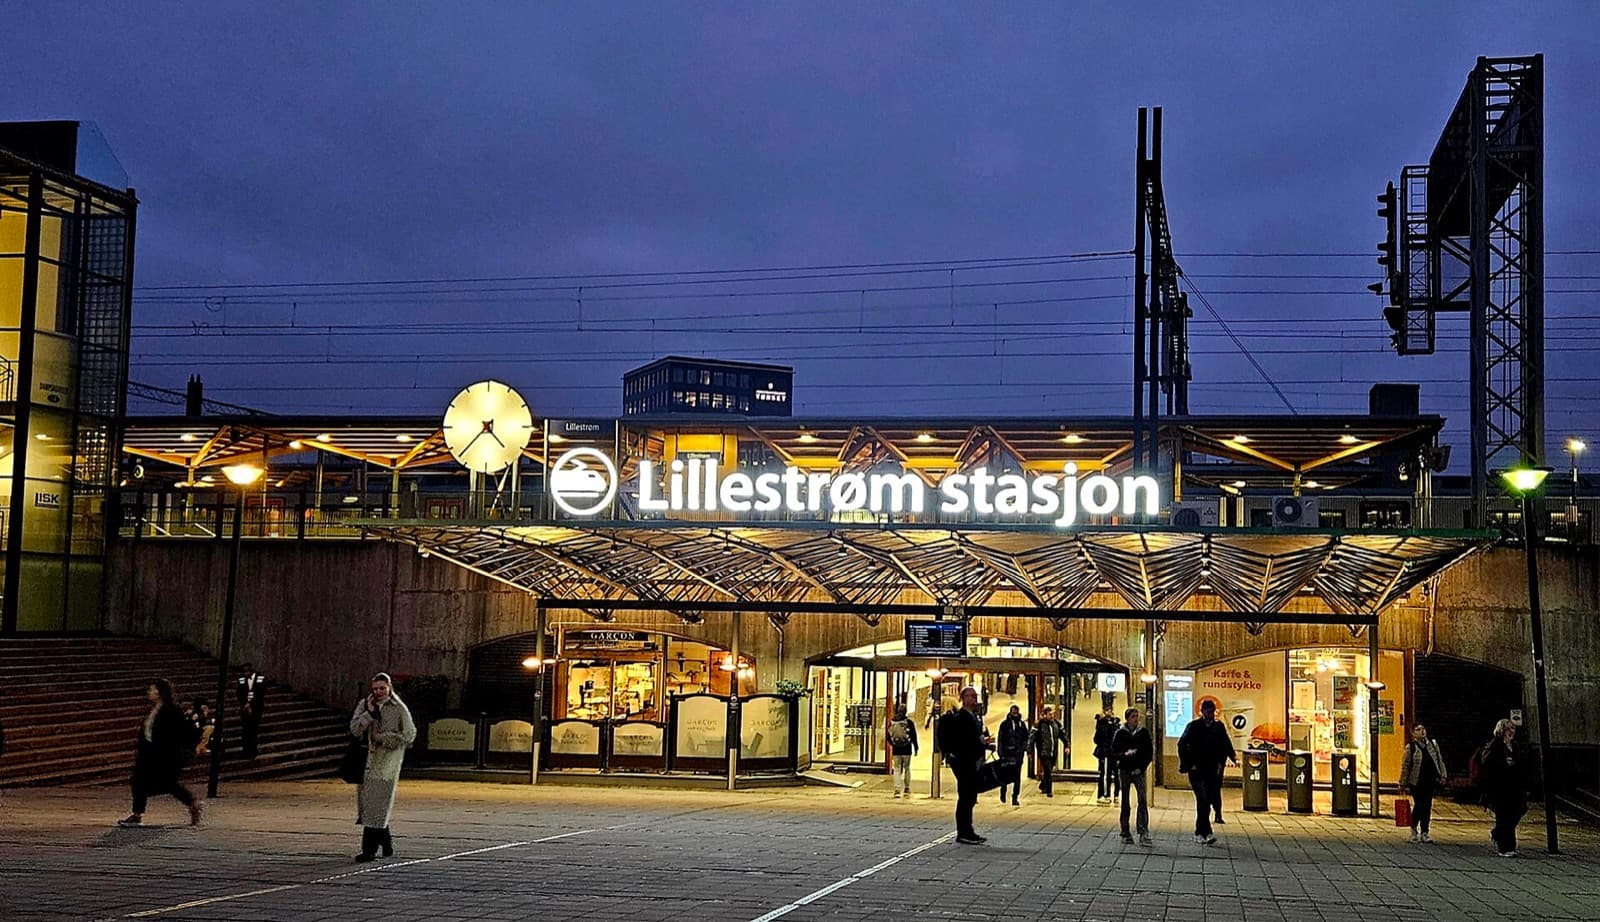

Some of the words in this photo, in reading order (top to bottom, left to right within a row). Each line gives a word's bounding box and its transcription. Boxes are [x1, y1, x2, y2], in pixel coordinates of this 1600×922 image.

[638, 459, 925, 513] Lillestrøm
[940, 462, 1161, 528] stasjon
[1213, 669, 1242, 678] Kaffe
[1243, 670, 1251, 678] &
[1203, 680, 1262, 691] rundstykke
